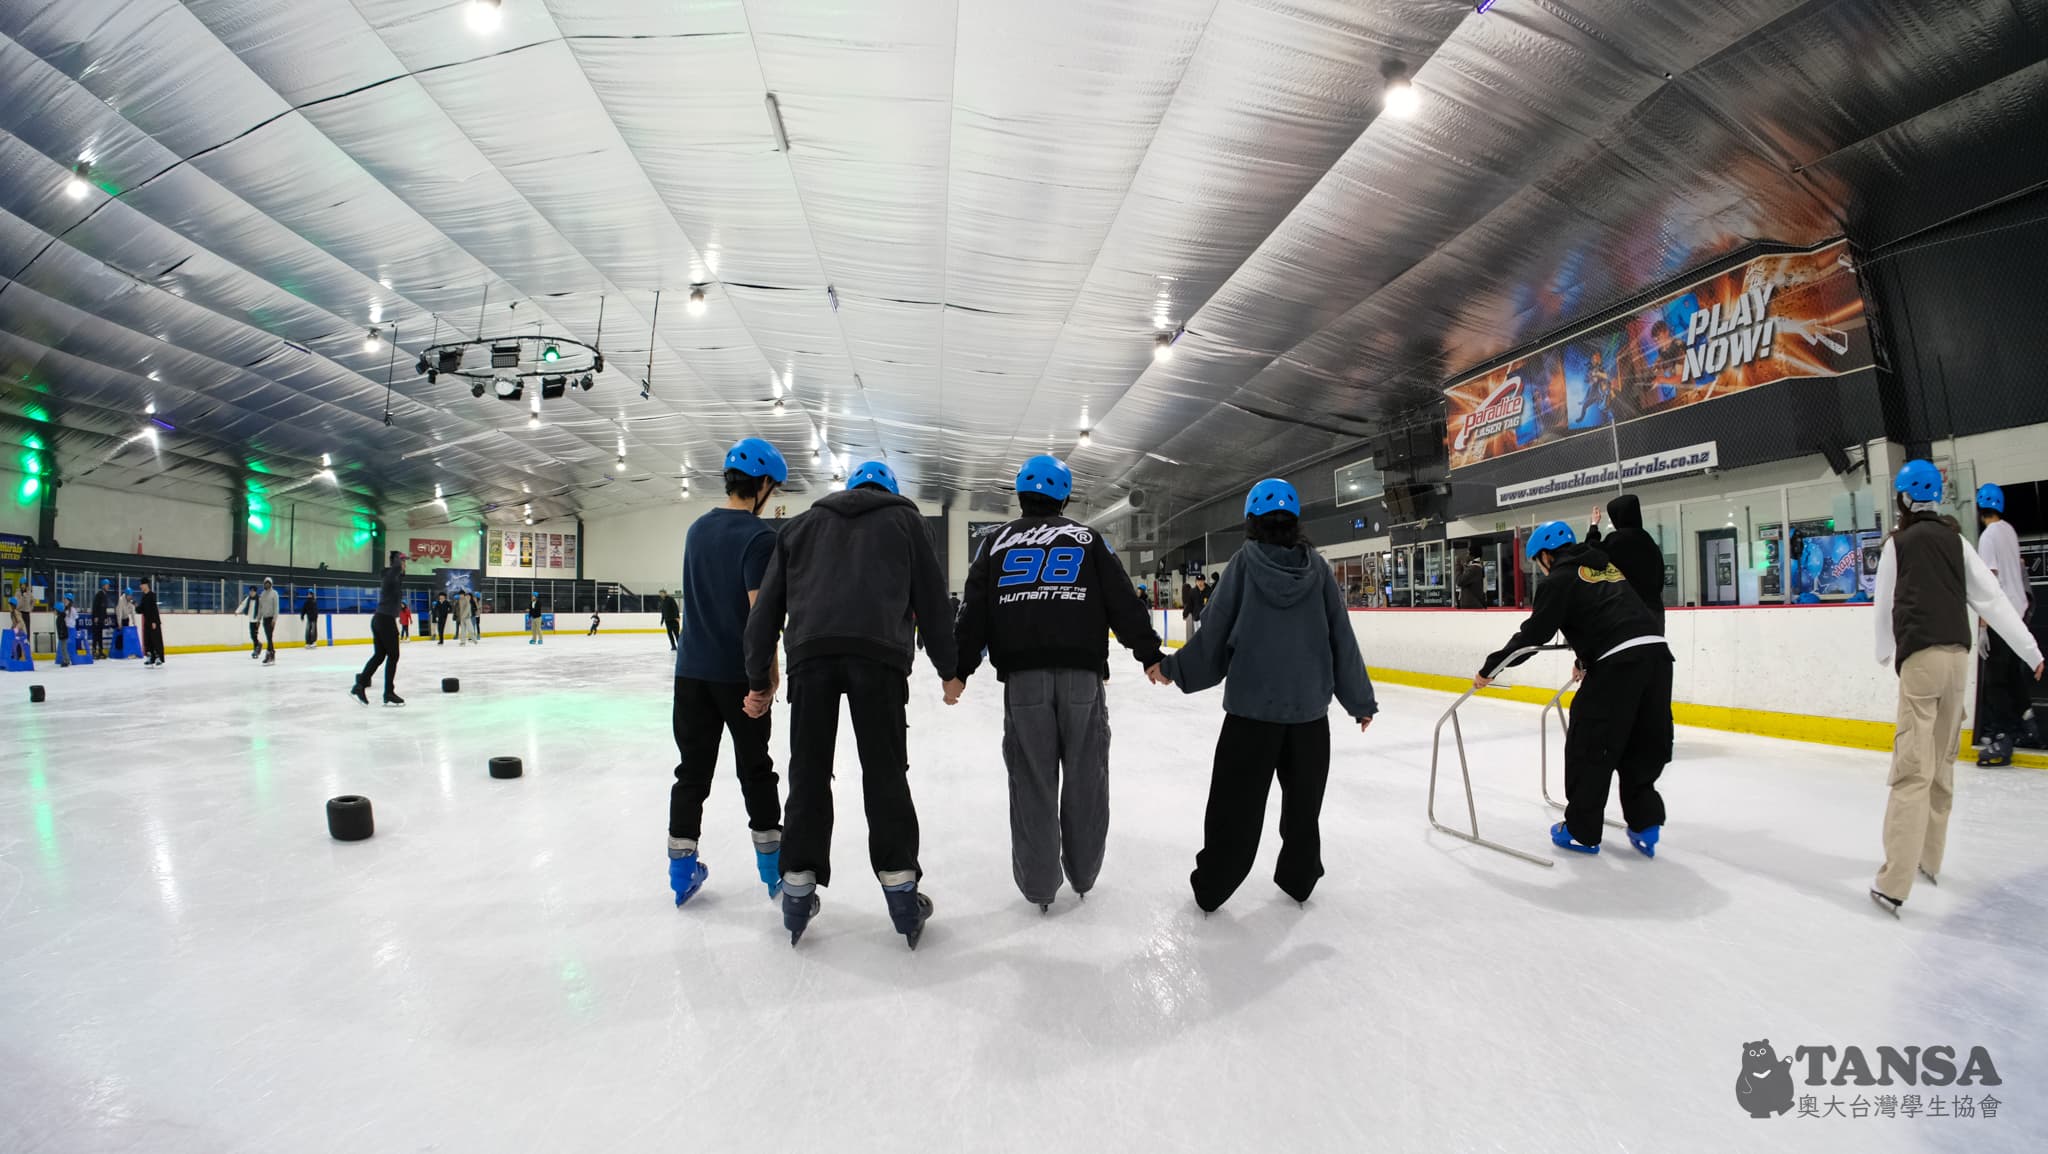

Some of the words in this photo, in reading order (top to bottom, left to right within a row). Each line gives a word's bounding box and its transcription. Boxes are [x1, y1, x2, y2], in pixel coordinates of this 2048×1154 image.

[1686, 283, 1776, 346] PLAY
[1681, 319, 1774, 382] NOW!
[1476, 422, 1502, 438] LASER
[1503, 416, 1520, 430] TAG
[416, 543, 447, 555] enjoy
[998, 546, 1085, 587] 98
